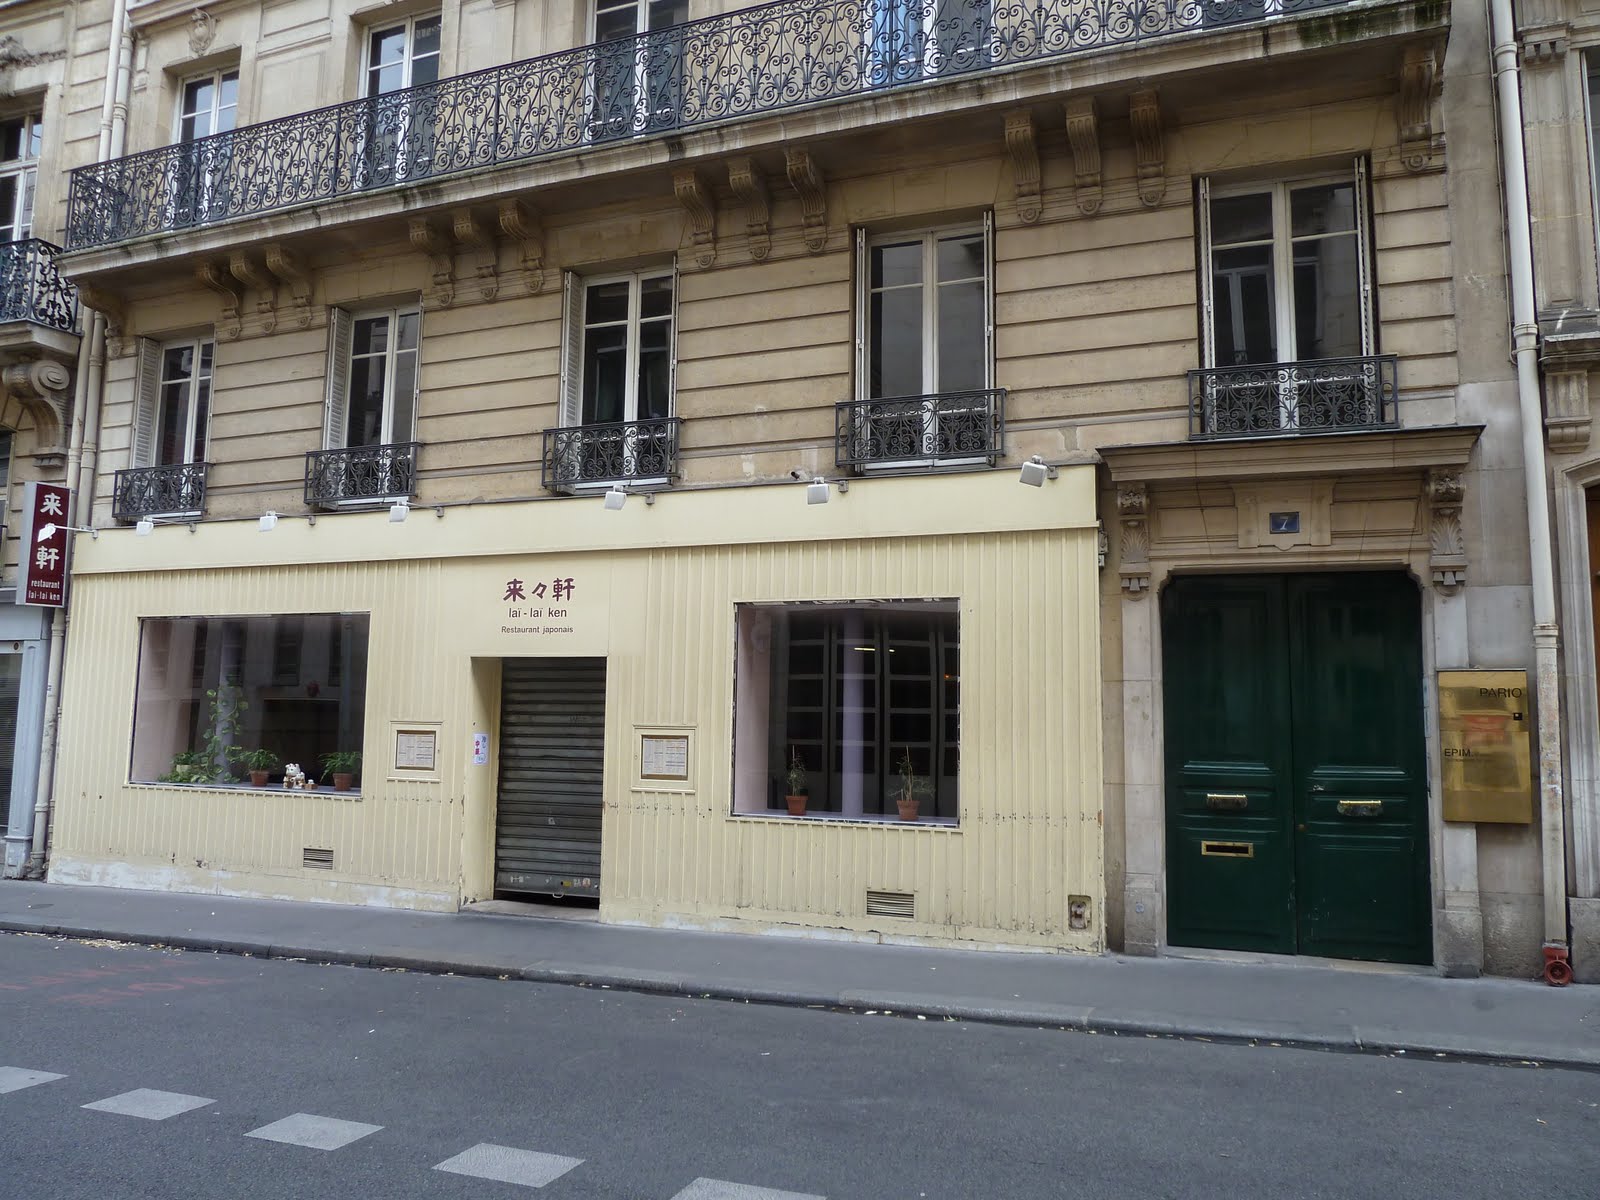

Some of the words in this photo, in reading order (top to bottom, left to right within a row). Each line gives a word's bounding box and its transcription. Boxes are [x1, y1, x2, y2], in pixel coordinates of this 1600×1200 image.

[1280, 516, 1288, 531] 7
[36, 492, 63, 571] 来軒
[31, 579, 60, 589] restaurant
[503, 578, 575, 602] 来々軒
[49, 592, 60, 601] ken
[548, 607, 567, 618] ken
[501, 625, 540, 634] Restaurant
[542, 625, 574, 635] japonais
[1479, 687, 1522, 698] PARIO
